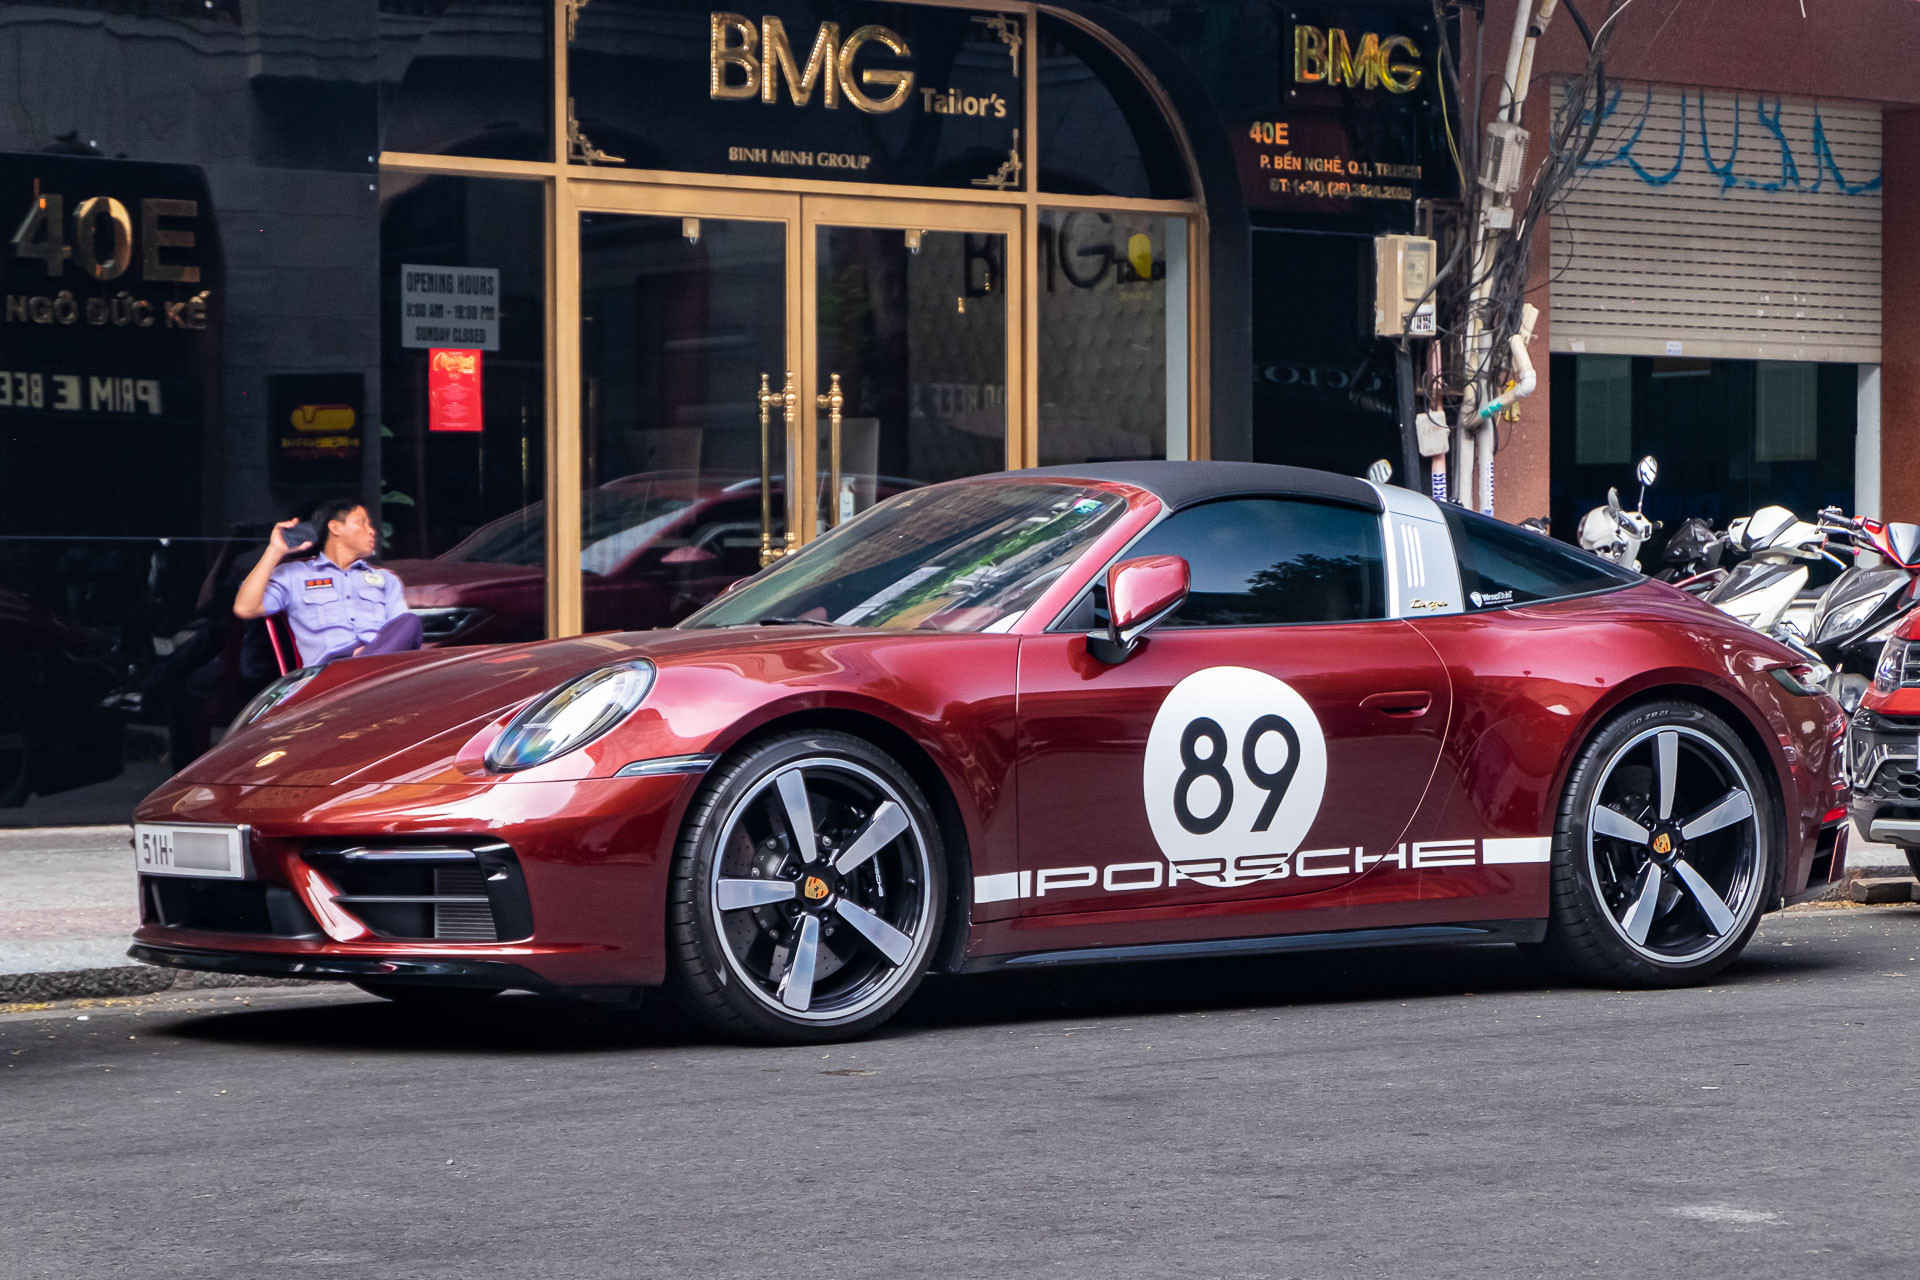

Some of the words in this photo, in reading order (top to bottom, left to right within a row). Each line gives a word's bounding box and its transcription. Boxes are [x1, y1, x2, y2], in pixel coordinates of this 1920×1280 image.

[710, 11, 915, 114] BMG
[919, 87, 1007, 118] Tailor's
[1295, 24, 1422, 94] BMG
[1249, 121, 1289, 145] 40E
[728, 146, 767, 163] BINH
[771, 149, 813, 166] MINH
[816, 152, 871, 169] GROUP
[10, 193, 201, 283] 40E
[406, 271, 454, 294] OPENING
[457, 274, 494, 296] HOURS
[6, 290, 78, 325] NGÔ
[429, 304, 444, 319] AM
[480, 306, 494, 321] PM
[415, 326, 450, 342] SUNDAY
[452, 328, 486, 344] CLOSED
[1410, 598, 1448, 611] Targa
[1173, 714, 1301, 836] 89
[1036, 840, 1476, 897] PORSCHE
